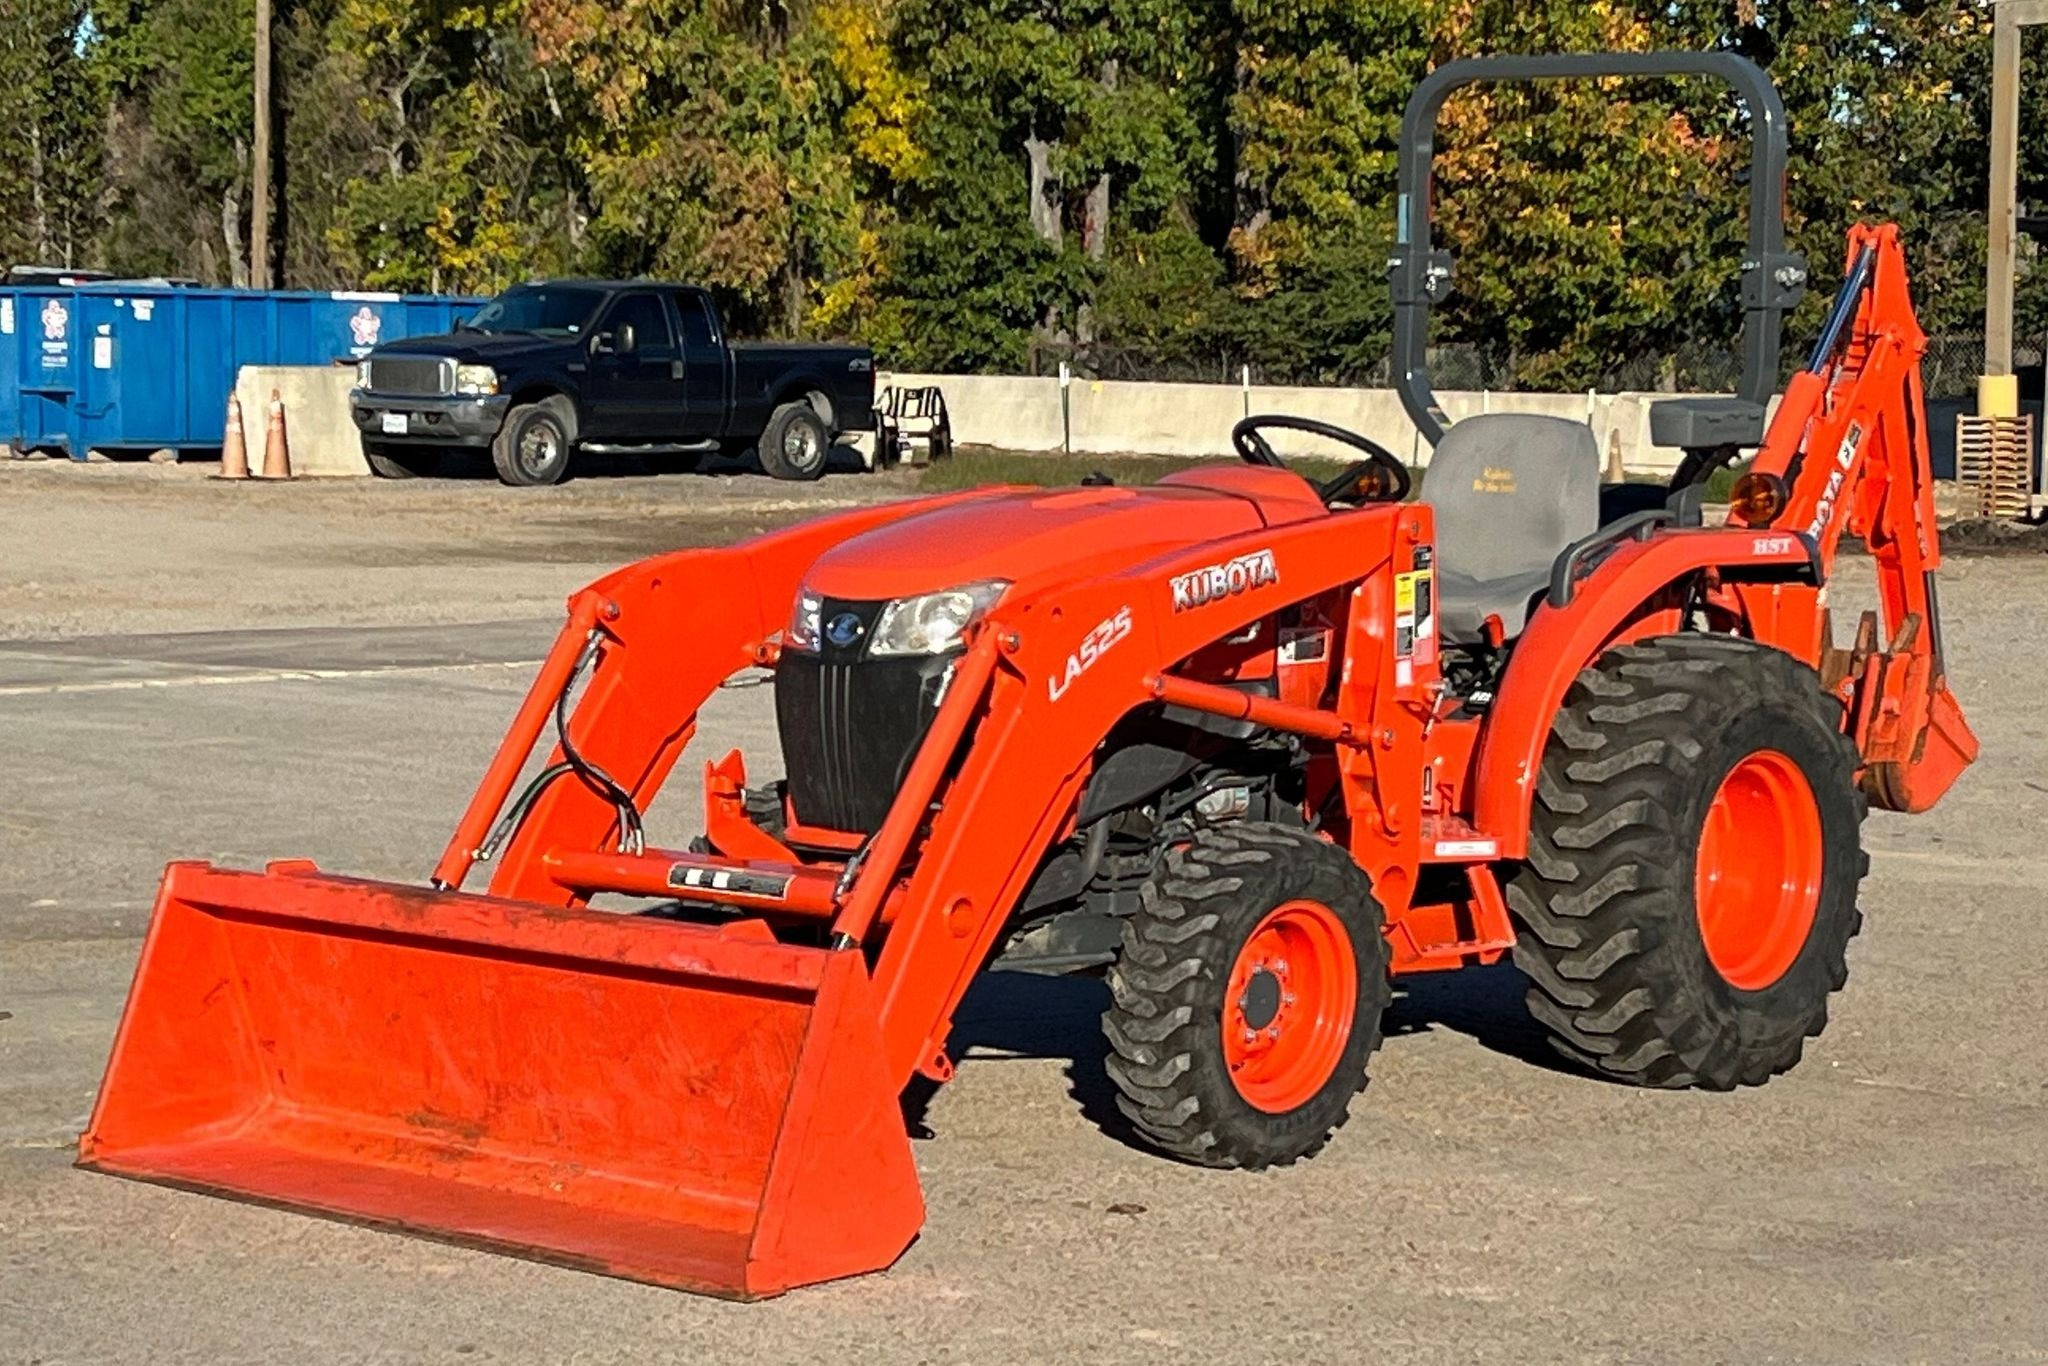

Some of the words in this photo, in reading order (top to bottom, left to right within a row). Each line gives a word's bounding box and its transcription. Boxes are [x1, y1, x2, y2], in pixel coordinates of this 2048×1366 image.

[1752, 537, 1792, 556] HST
[1169, 549, 1279, 615] KUBOTA
[1048, 604, 1132, 702] LA525
